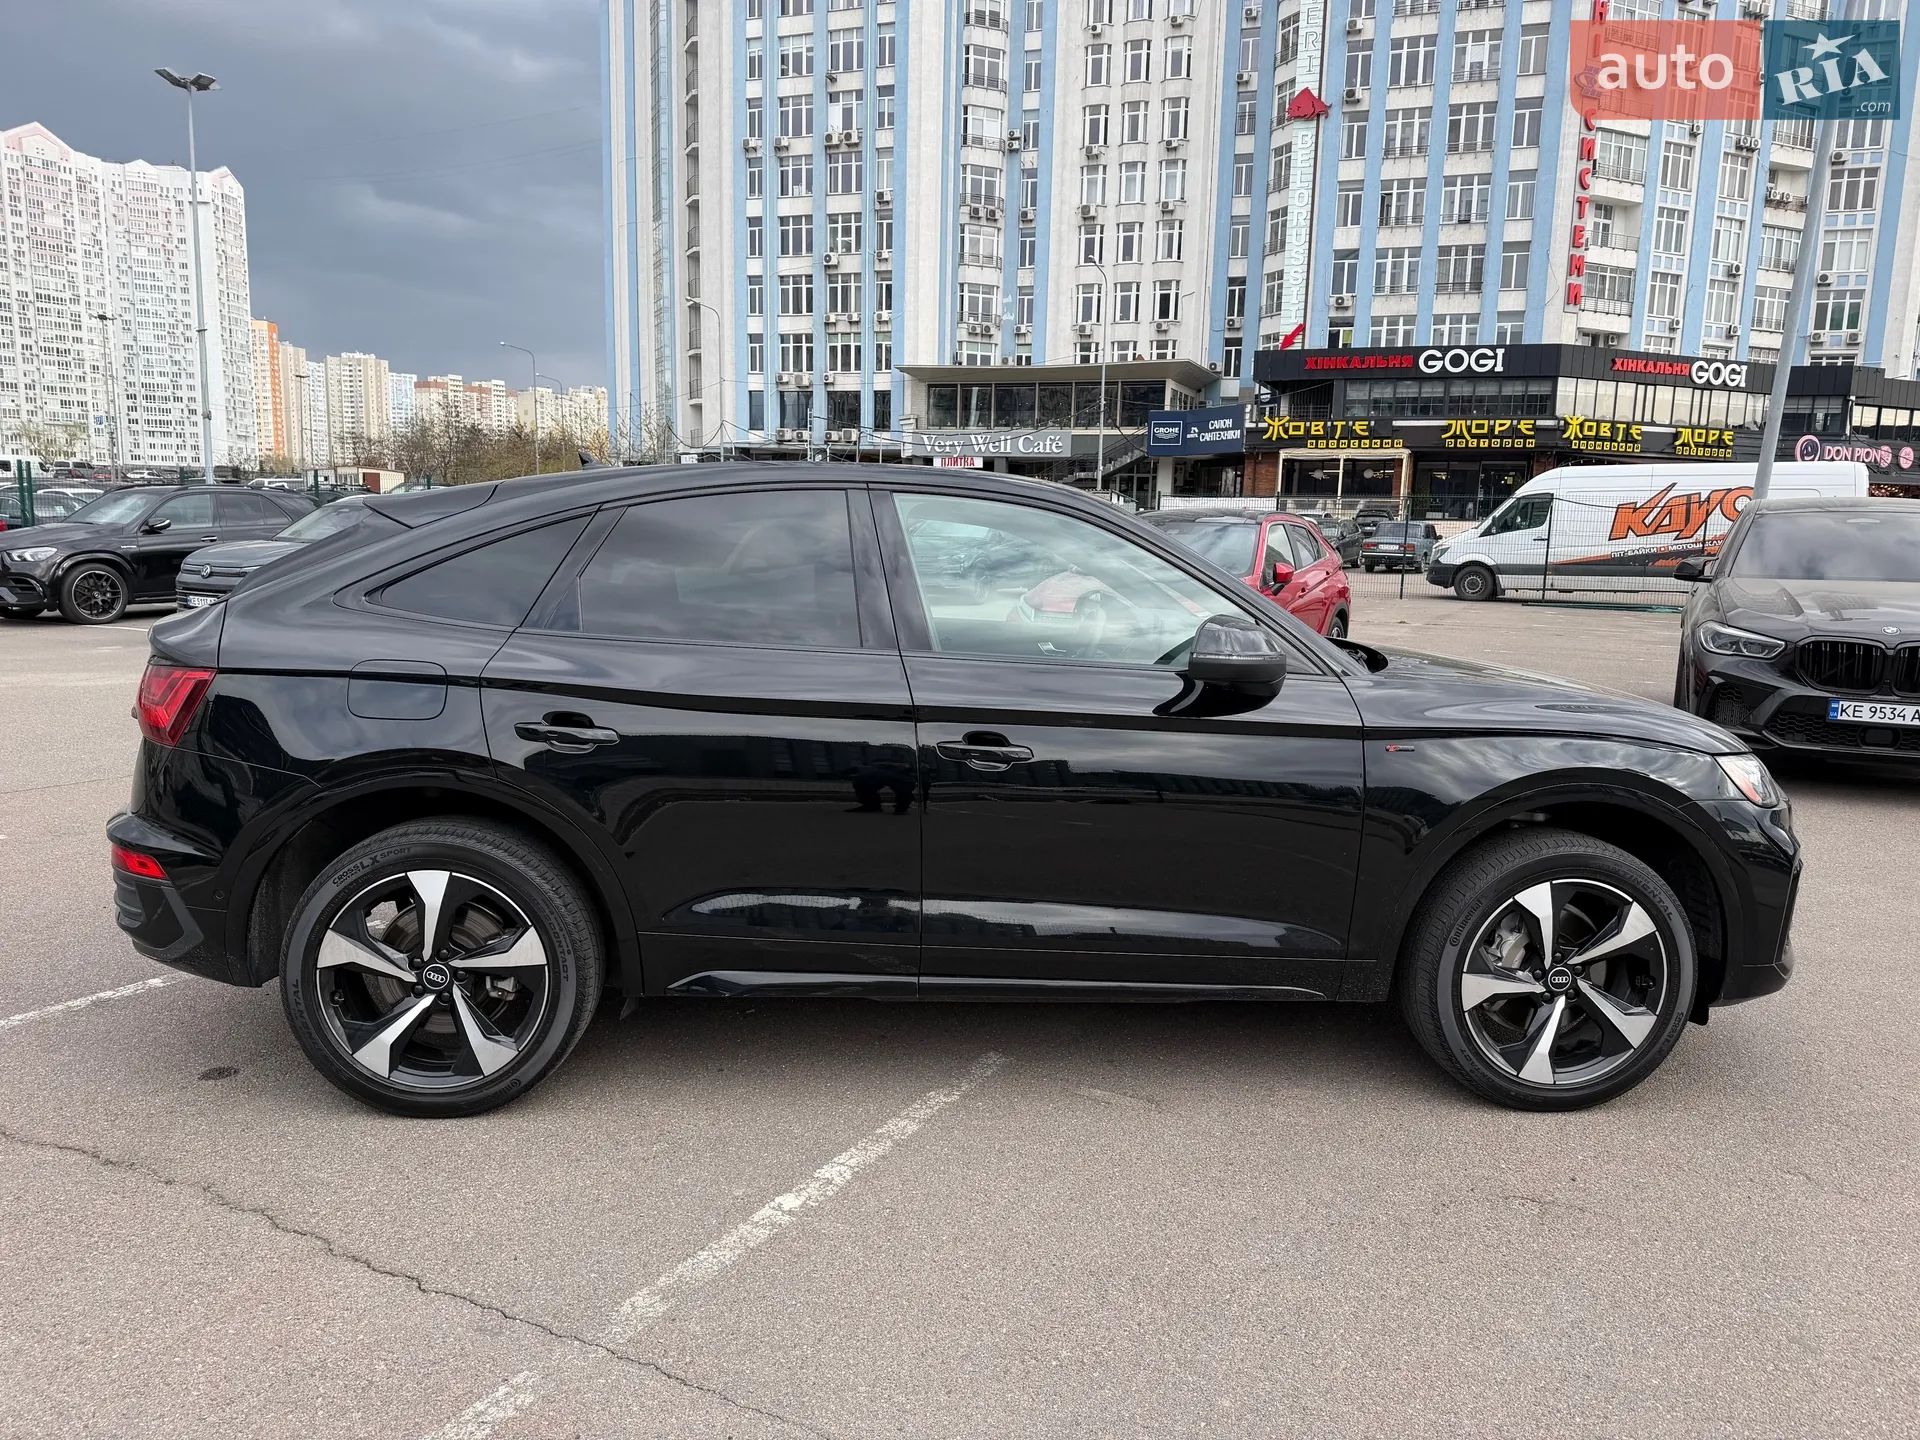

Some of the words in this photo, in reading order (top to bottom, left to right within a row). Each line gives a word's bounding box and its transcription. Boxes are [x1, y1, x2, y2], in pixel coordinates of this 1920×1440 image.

[1304, 0, 1321, 73] ERI
[1567, 107, 1597, 306] СИСТЕМИ
[1289, 131, 1314, 323] BELORUSSII
[1303, 354, 1414, 370] ХІНКАЛЬНЯ
[1418, 347, 1505, 374] GOGI
[1612, 357, 1691, 377] ХІНКАЛЬНЯ
[1690, 360, 1748, 388] GOGI
[1199, 429, 1241, 442] САНТЕХНІКИ
[1208, 418, 1233, 430] САЛОН
[1262, 415, 1369, 441] ЖОВТЕ
[1562, 415, 1642, 442] ЖОВТЕ
[920, 434, 966, 458] Very
[969, 434, 1013, 453] Well
[1017, 434, 1064, 453] Café
[1824, 445, 1853, 461] DON
[1853, 447, 1880, 463] PION
[940, 457, 976, 468] ПЛИТКА
[1840, 703, 1864, 718] KE
[1868, 706, 1906, 721] 9534
[332, 863, 360, 885] CROSS
[359, 854, 381, 870] LX
[379, 847, 412, 859] SPORT
